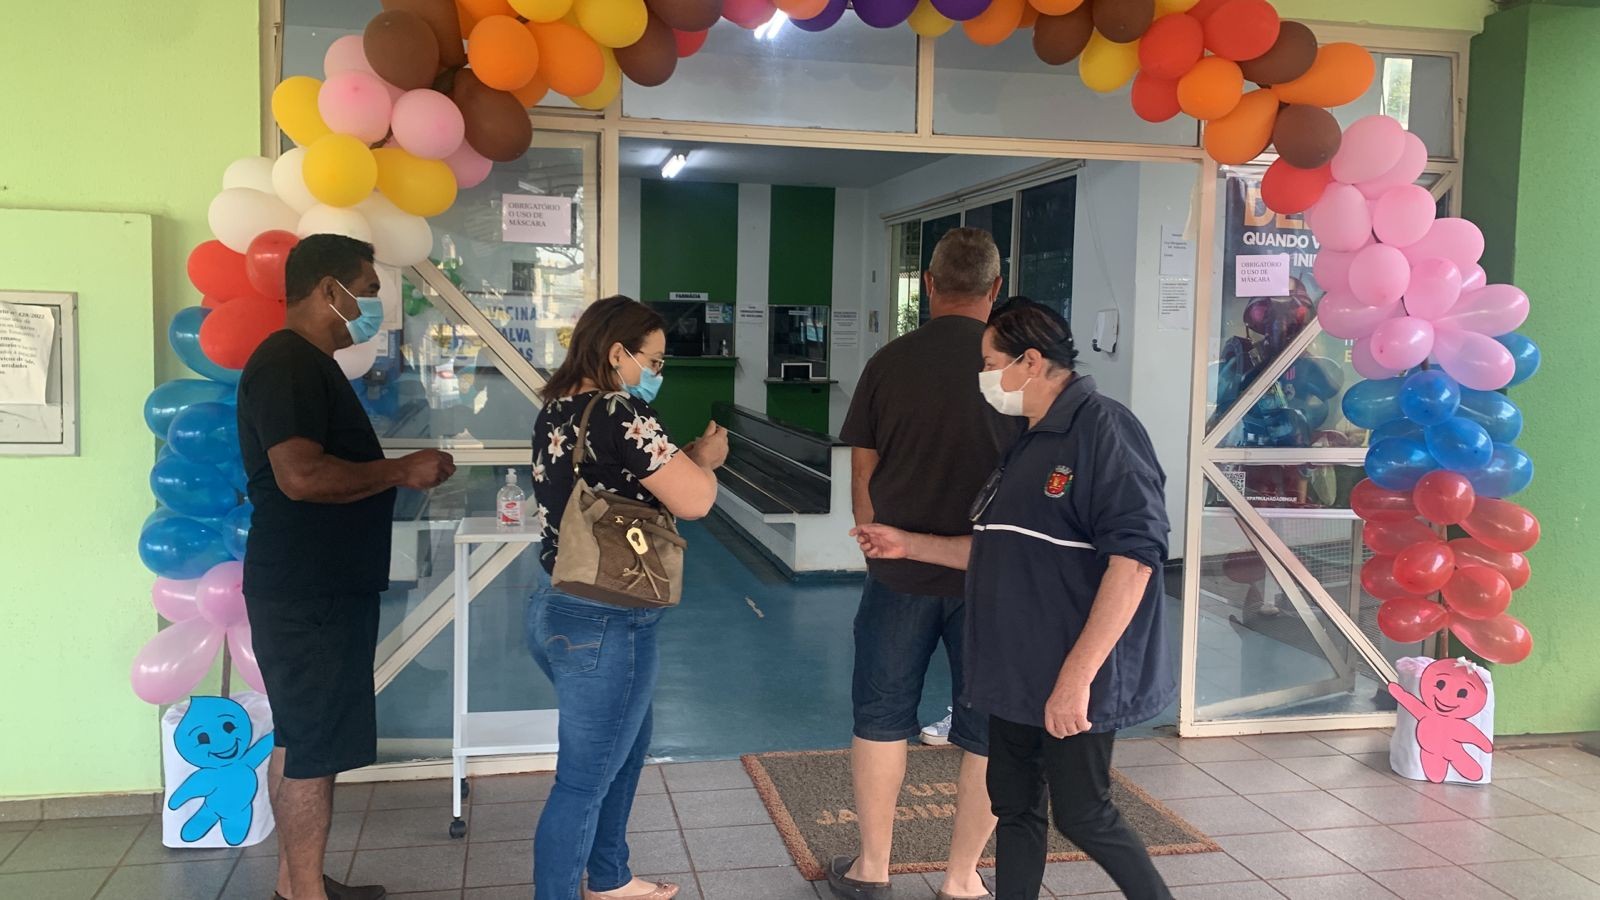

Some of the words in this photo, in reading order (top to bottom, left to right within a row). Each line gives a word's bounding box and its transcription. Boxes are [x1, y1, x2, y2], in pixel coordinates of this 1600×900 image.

[508, 201, 561, 211] OBRIGATÓRIO
[508, 218, 547, 227] MÁSCARA
[1243, 231, 1309, 249] QUANDO
[1312, 236, 1320, 249] V
[1293, 253, 1317, 267] INI
[498, 327, 531, 342] ALVA
